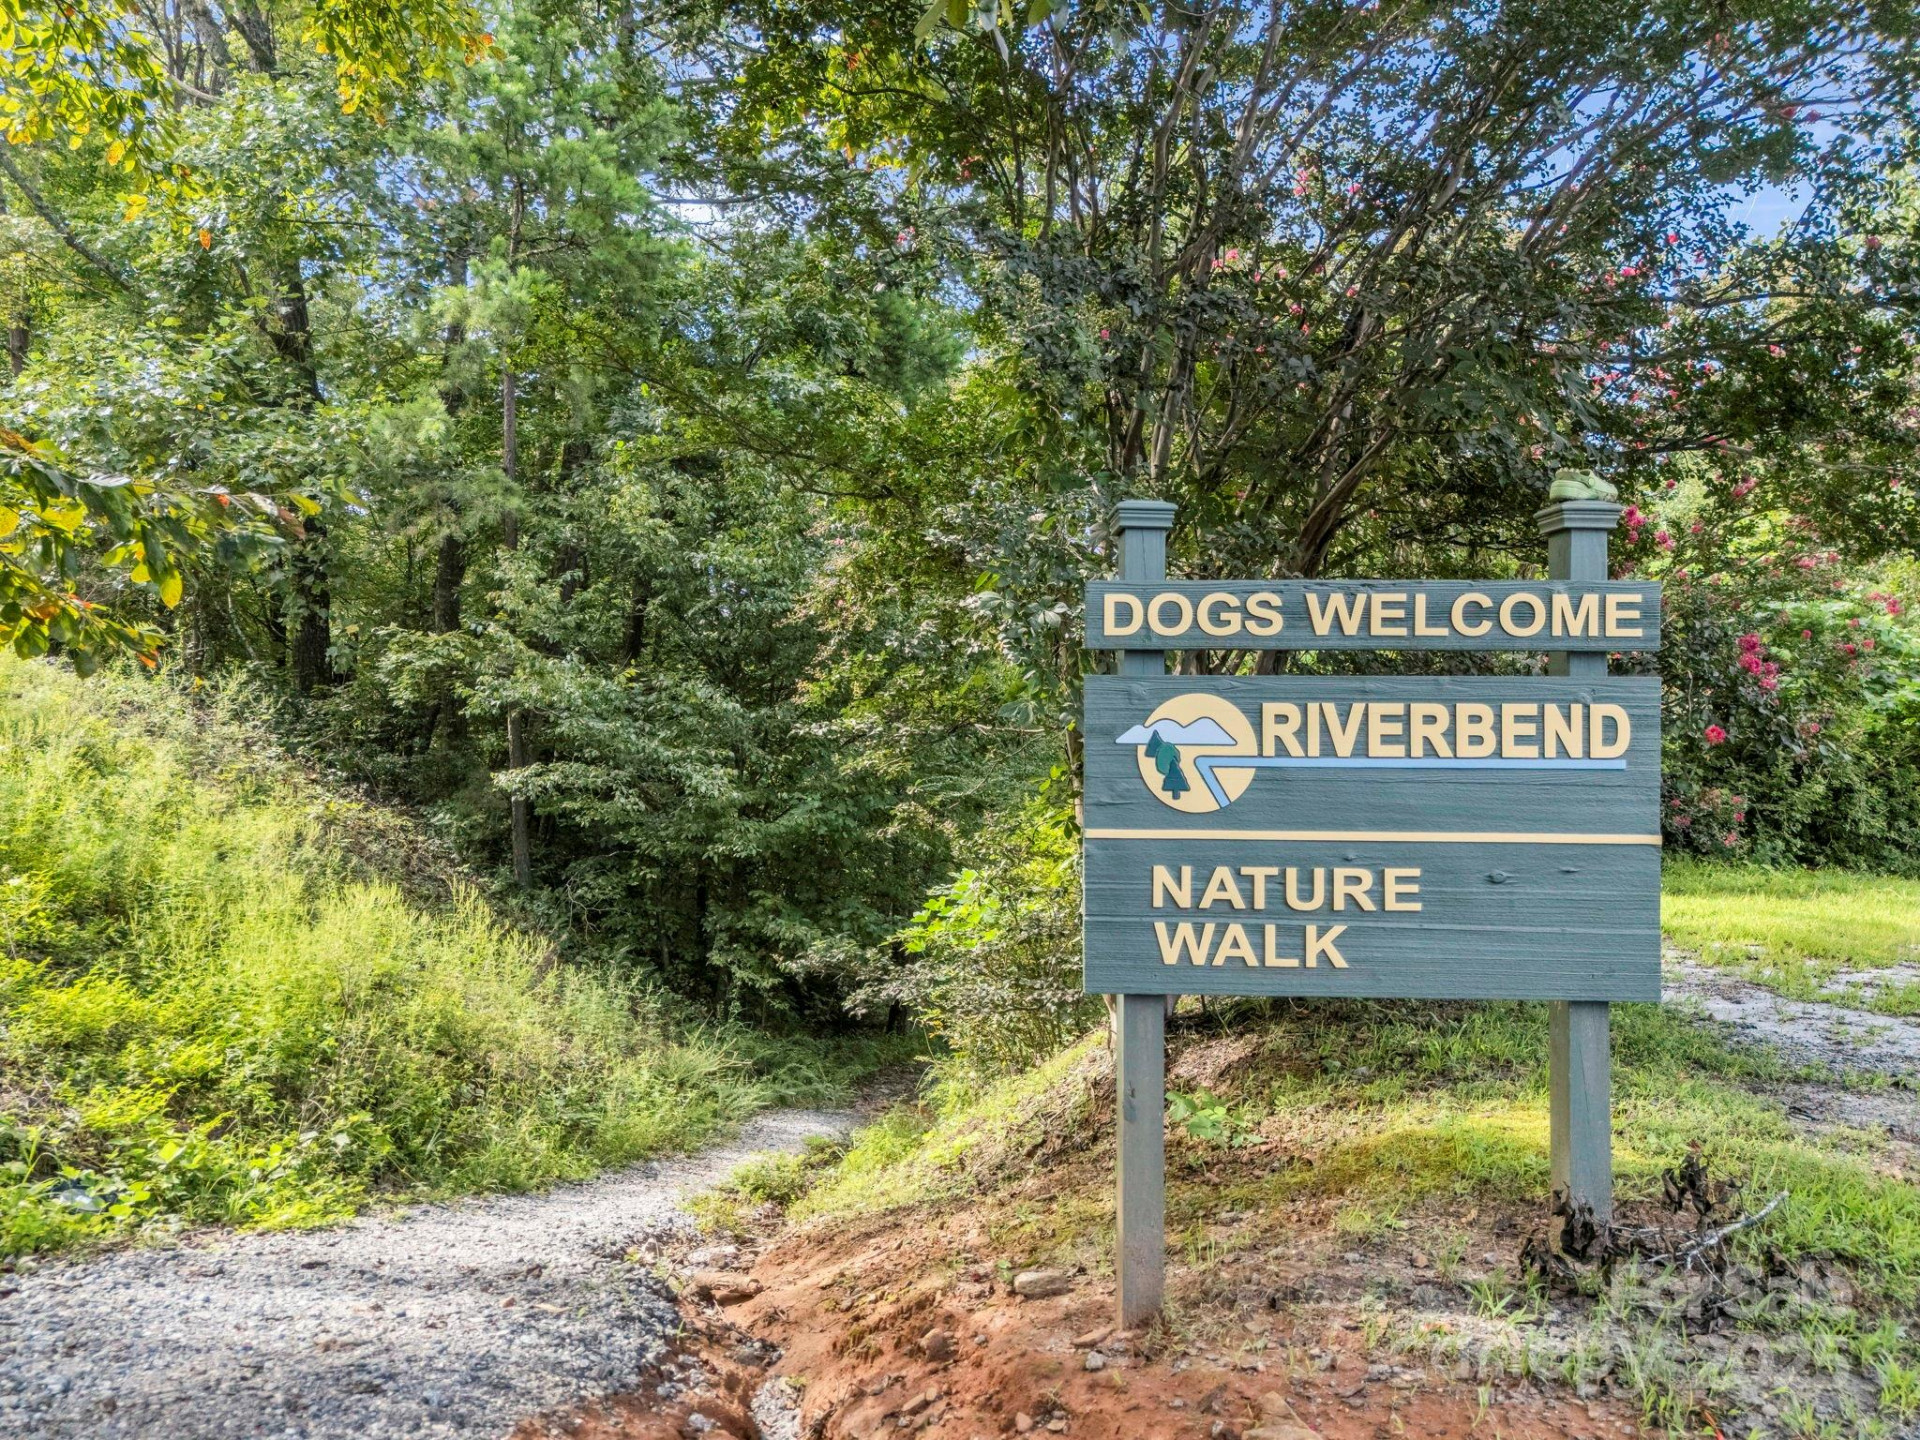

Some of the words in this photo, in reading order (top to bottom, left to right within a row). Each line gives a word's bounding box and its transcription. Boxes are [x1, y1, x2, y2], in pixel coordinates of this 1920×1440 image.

[1103, 593, 1283, 636] DOGS
[1306, 593, 1642, 637] WELCOME
[1262, 702, 1630, 758] RIVERBEND
[1152, 865, 1421, 911] NATURE
[1154, 922, 1347, 968] WALK
